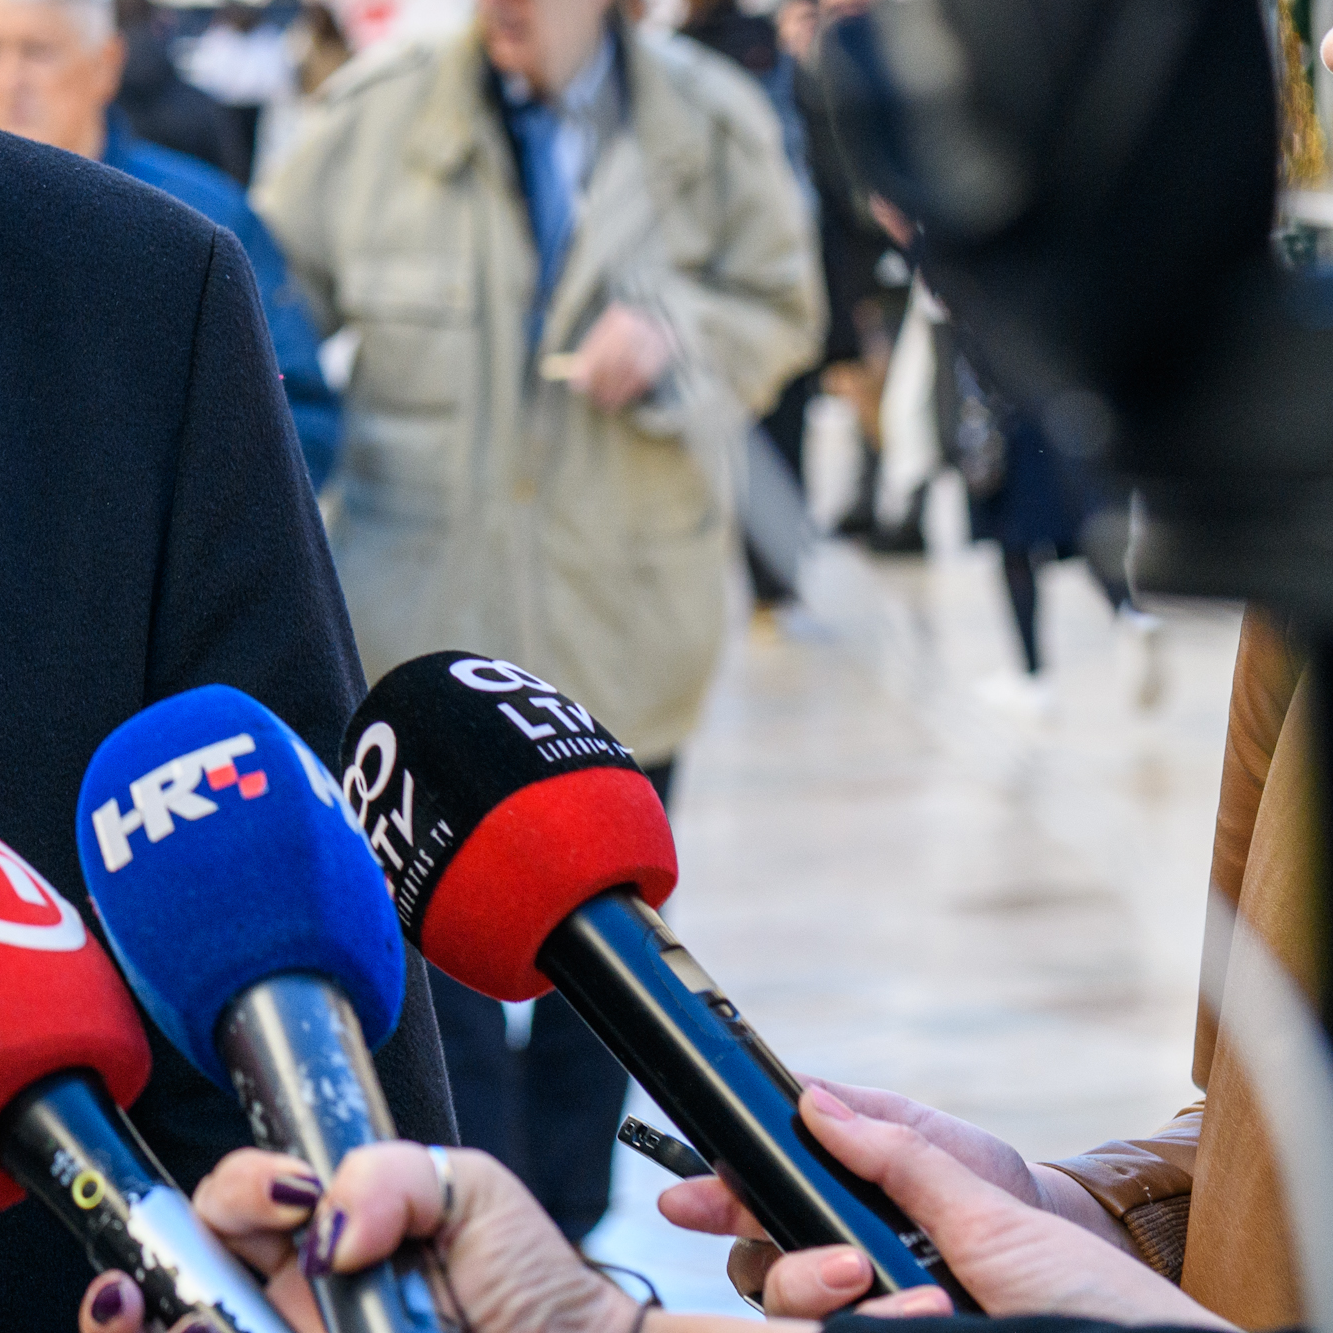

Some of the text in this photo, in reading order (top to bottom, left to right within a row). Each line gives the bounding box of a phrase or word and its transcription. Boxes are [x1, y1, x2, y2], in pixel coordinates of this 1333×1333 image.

[497, 697, 595, 741] LTV
[92, 732, 256, 873] HRT
[370, 767, 415, 900] TV
[430, 819, 454, 848] TV
